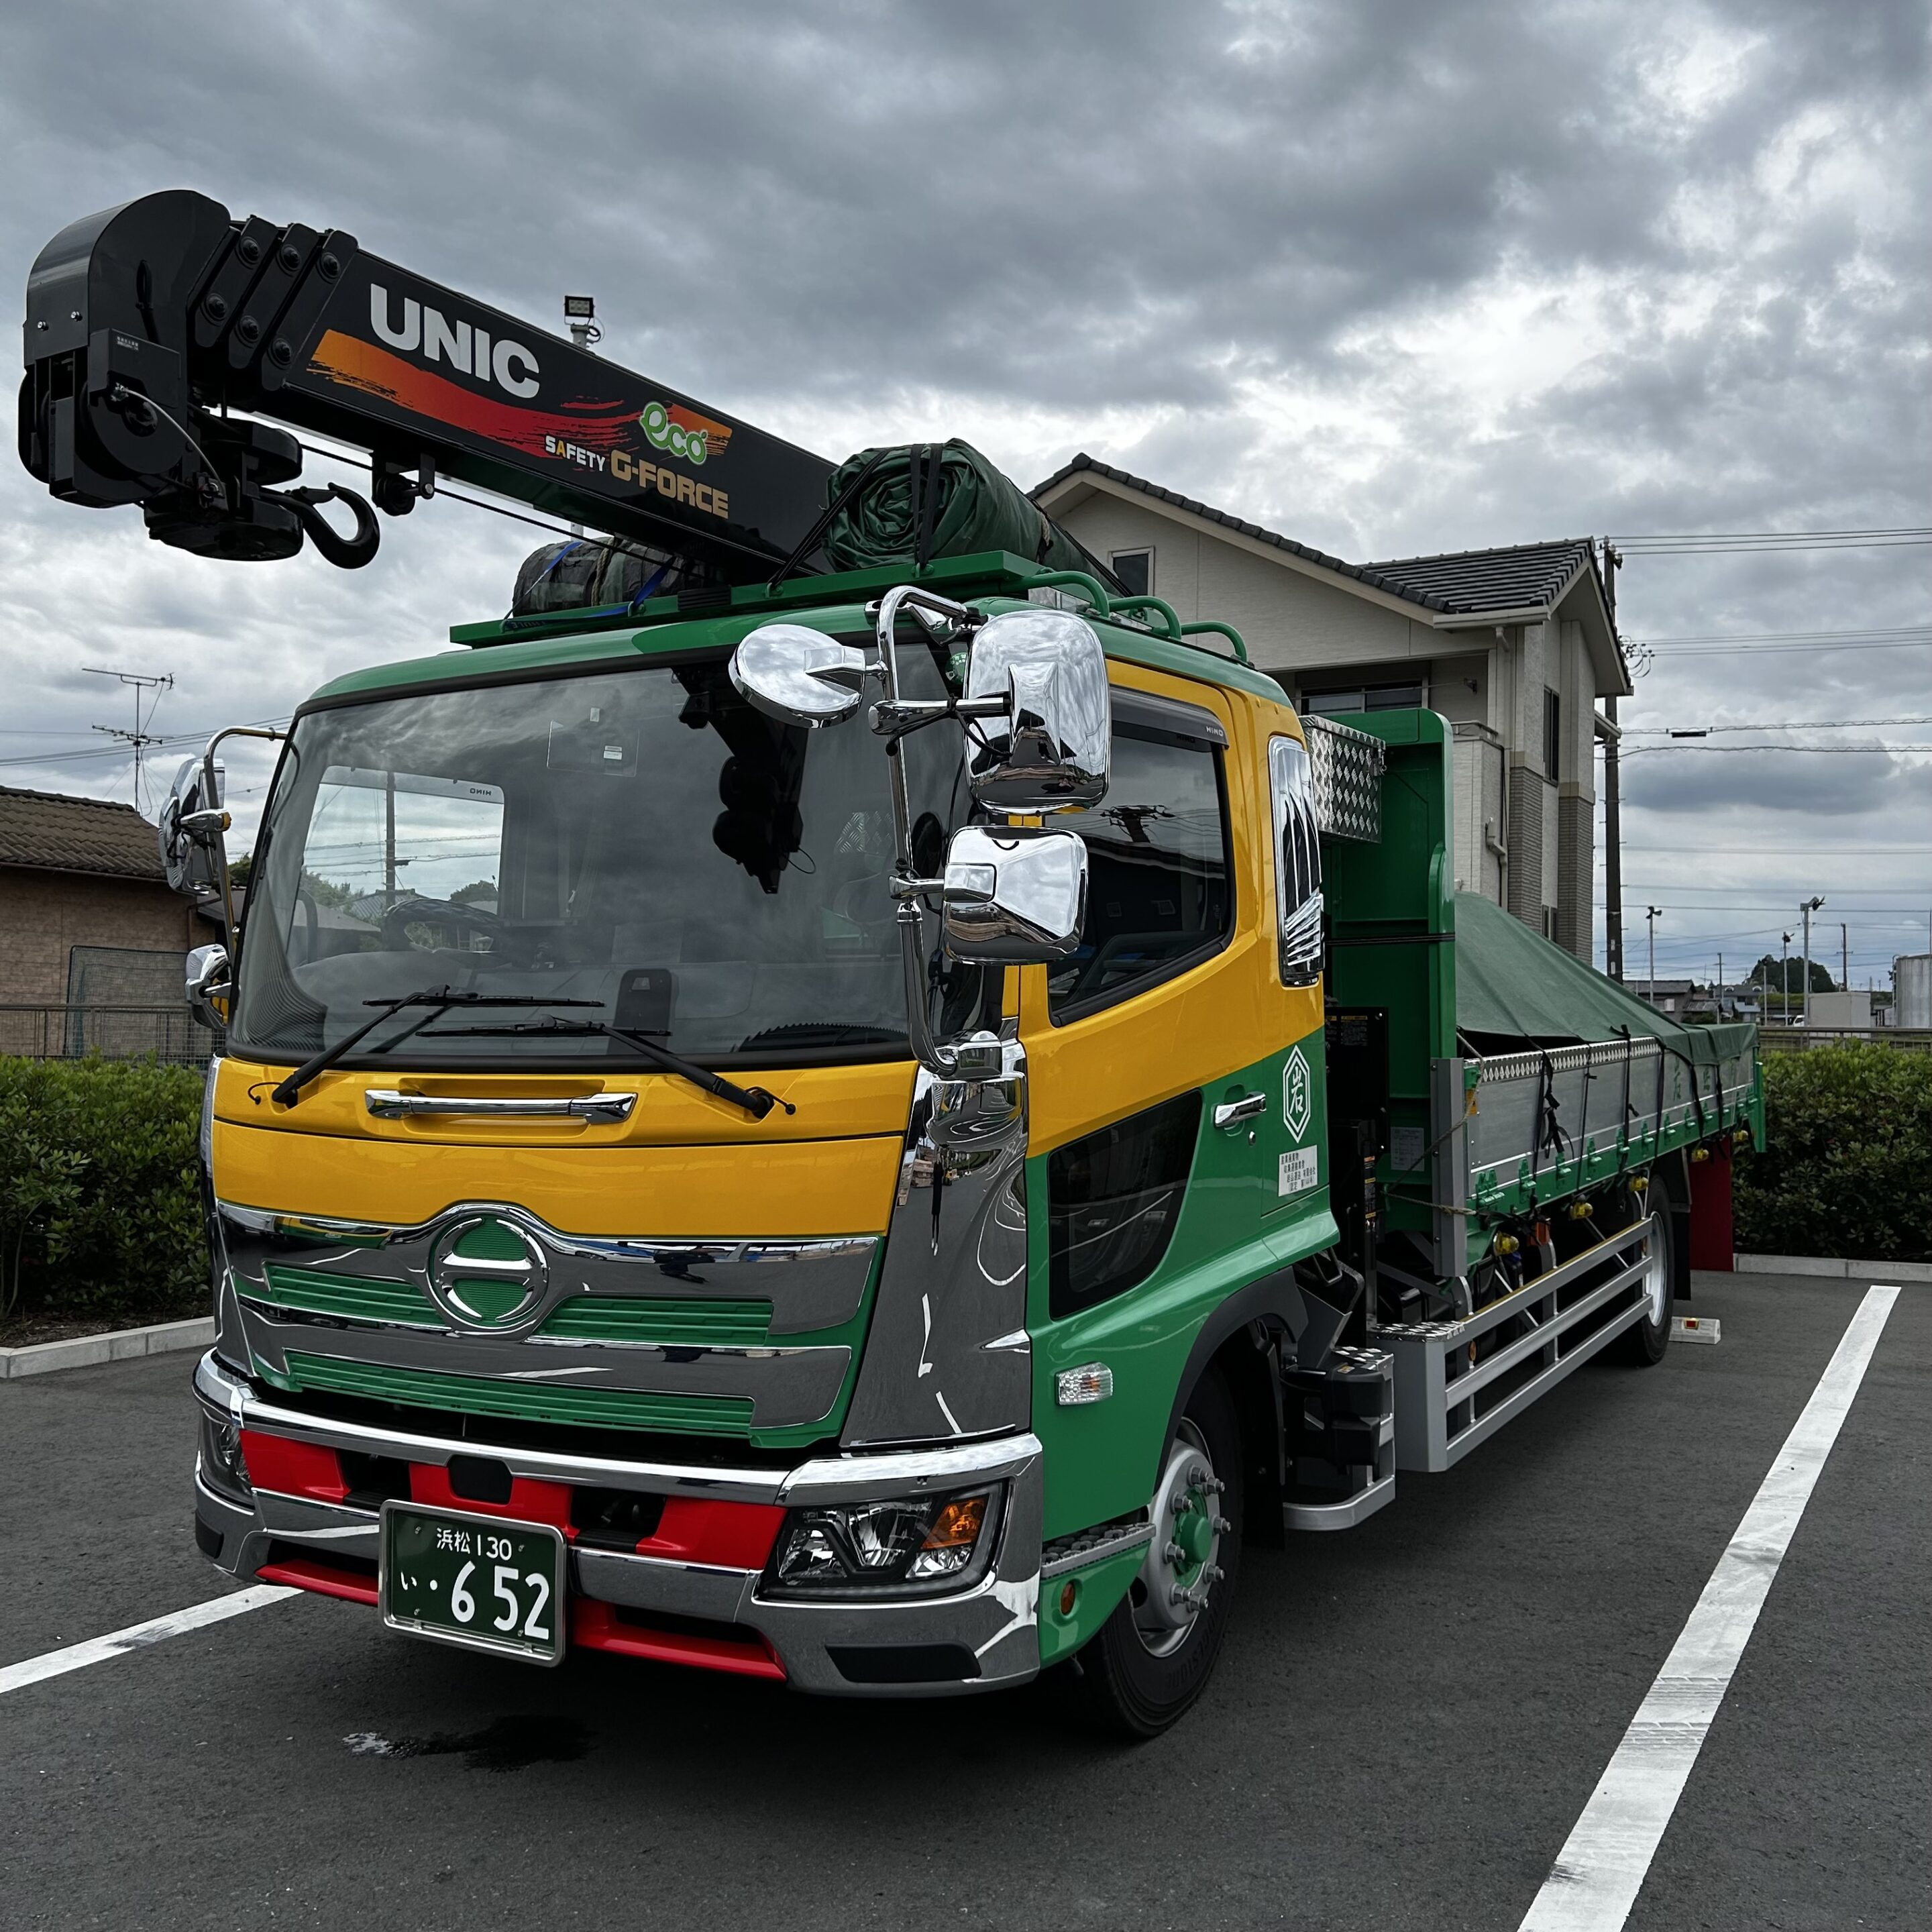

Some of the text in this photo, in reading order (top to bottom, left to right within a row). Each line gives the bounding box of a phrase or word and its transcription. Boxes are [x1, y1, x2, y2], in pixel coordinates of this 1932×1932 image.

[370, 283, 540, 399] UNIC
[545, 434, 729, 519] SAFETY G-FORCE
[1205, 726, 1224, 737] HINO
[1289, 1065, 1303, 1114] 岩
[436, 1527, 471, 1554] 浜松
[400, 1572, 417, 1591] い
